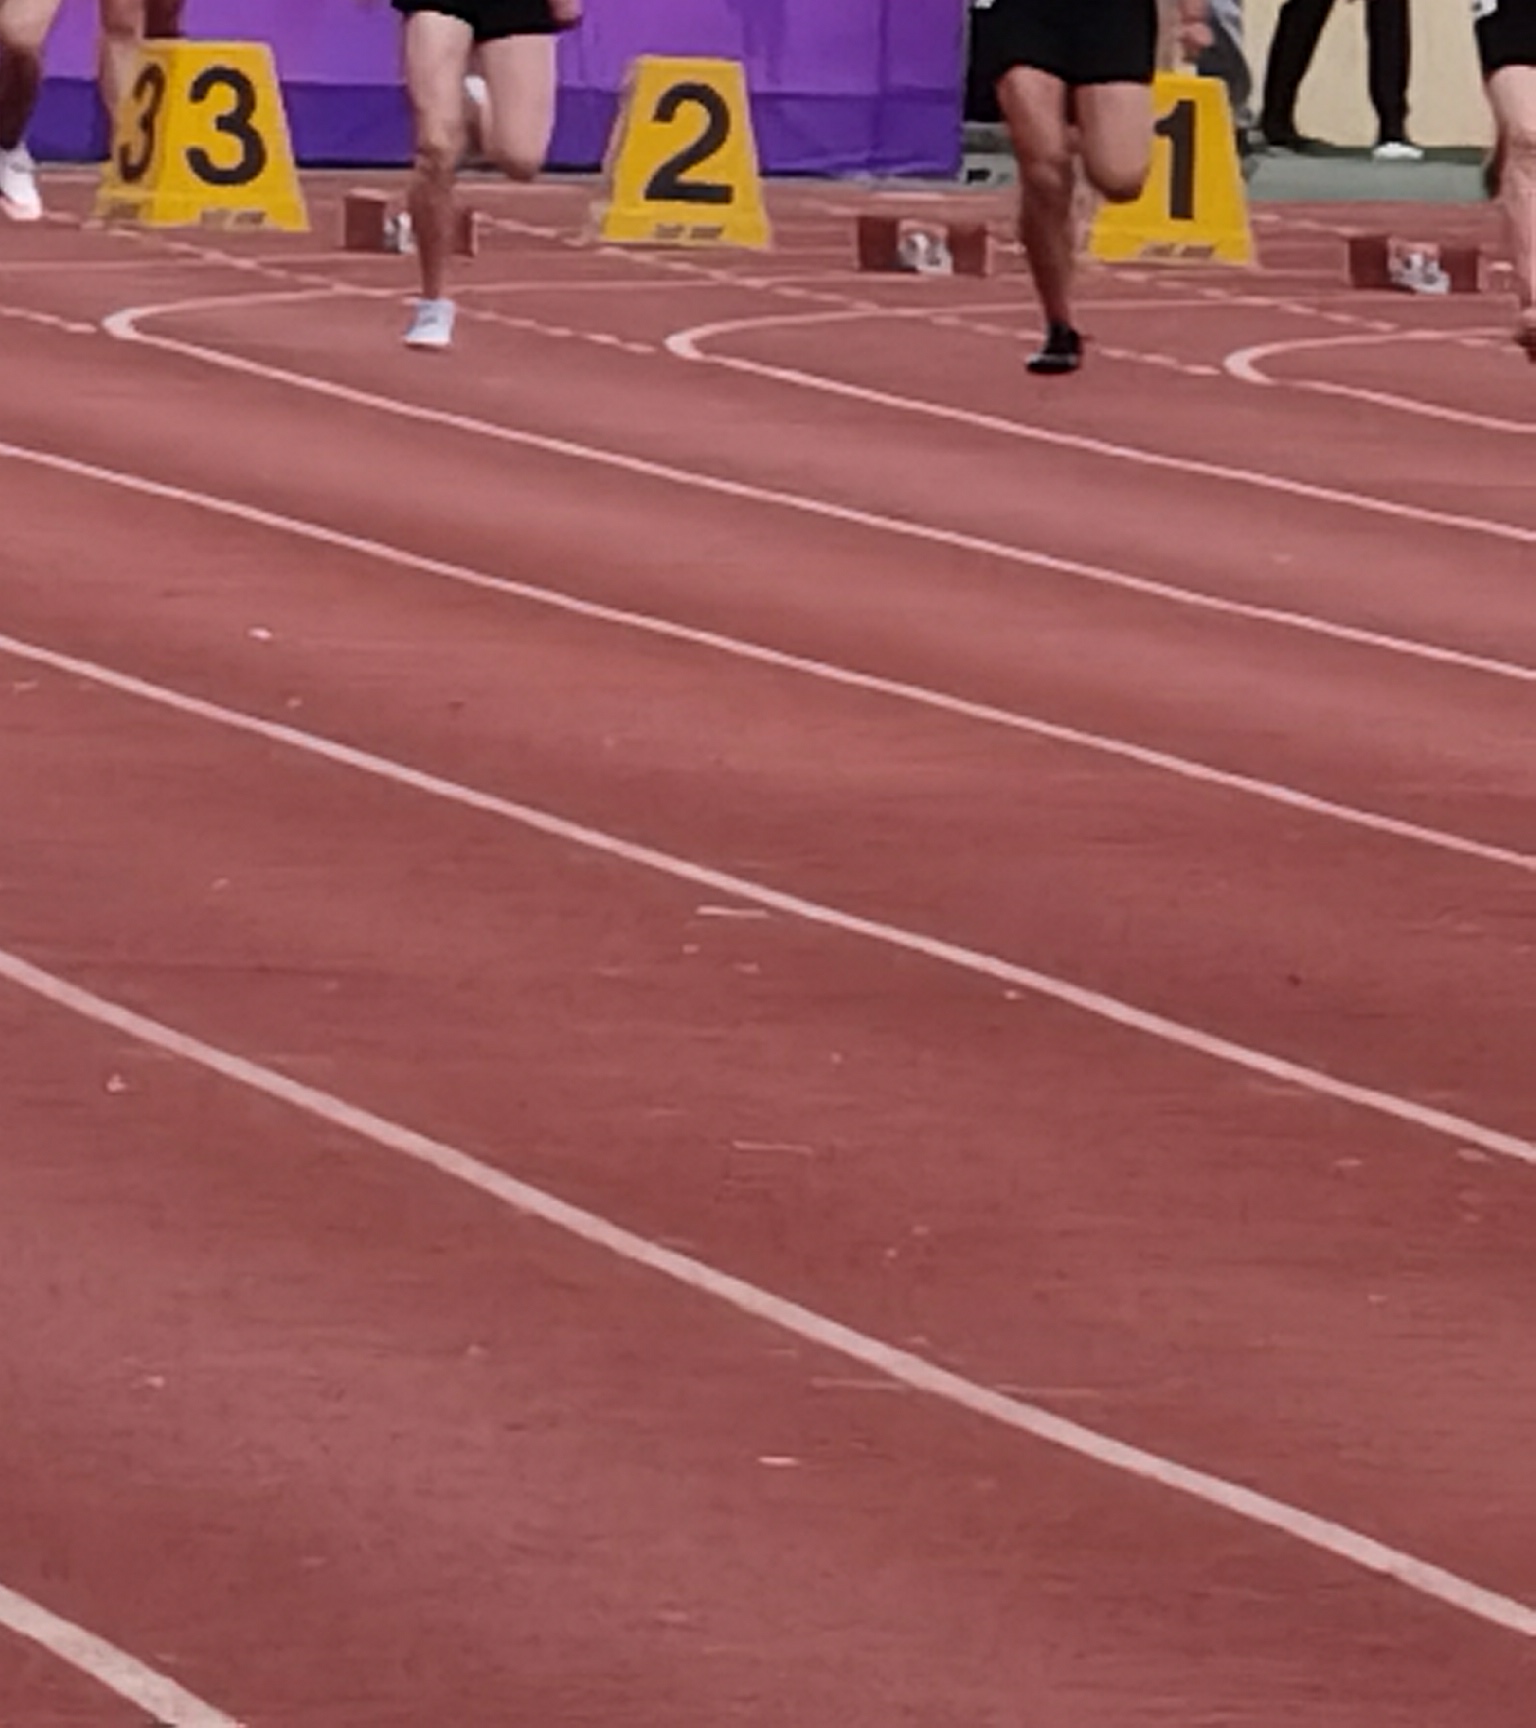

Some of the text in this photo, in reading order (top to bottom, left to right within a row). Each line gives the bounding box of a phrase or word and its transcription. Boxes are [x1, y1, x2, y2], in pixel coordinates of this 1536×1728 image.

[184, 65, 267, 186] 3
[642, 81, 736, 205] 2
[1154, 99, 1198, 221] 1
